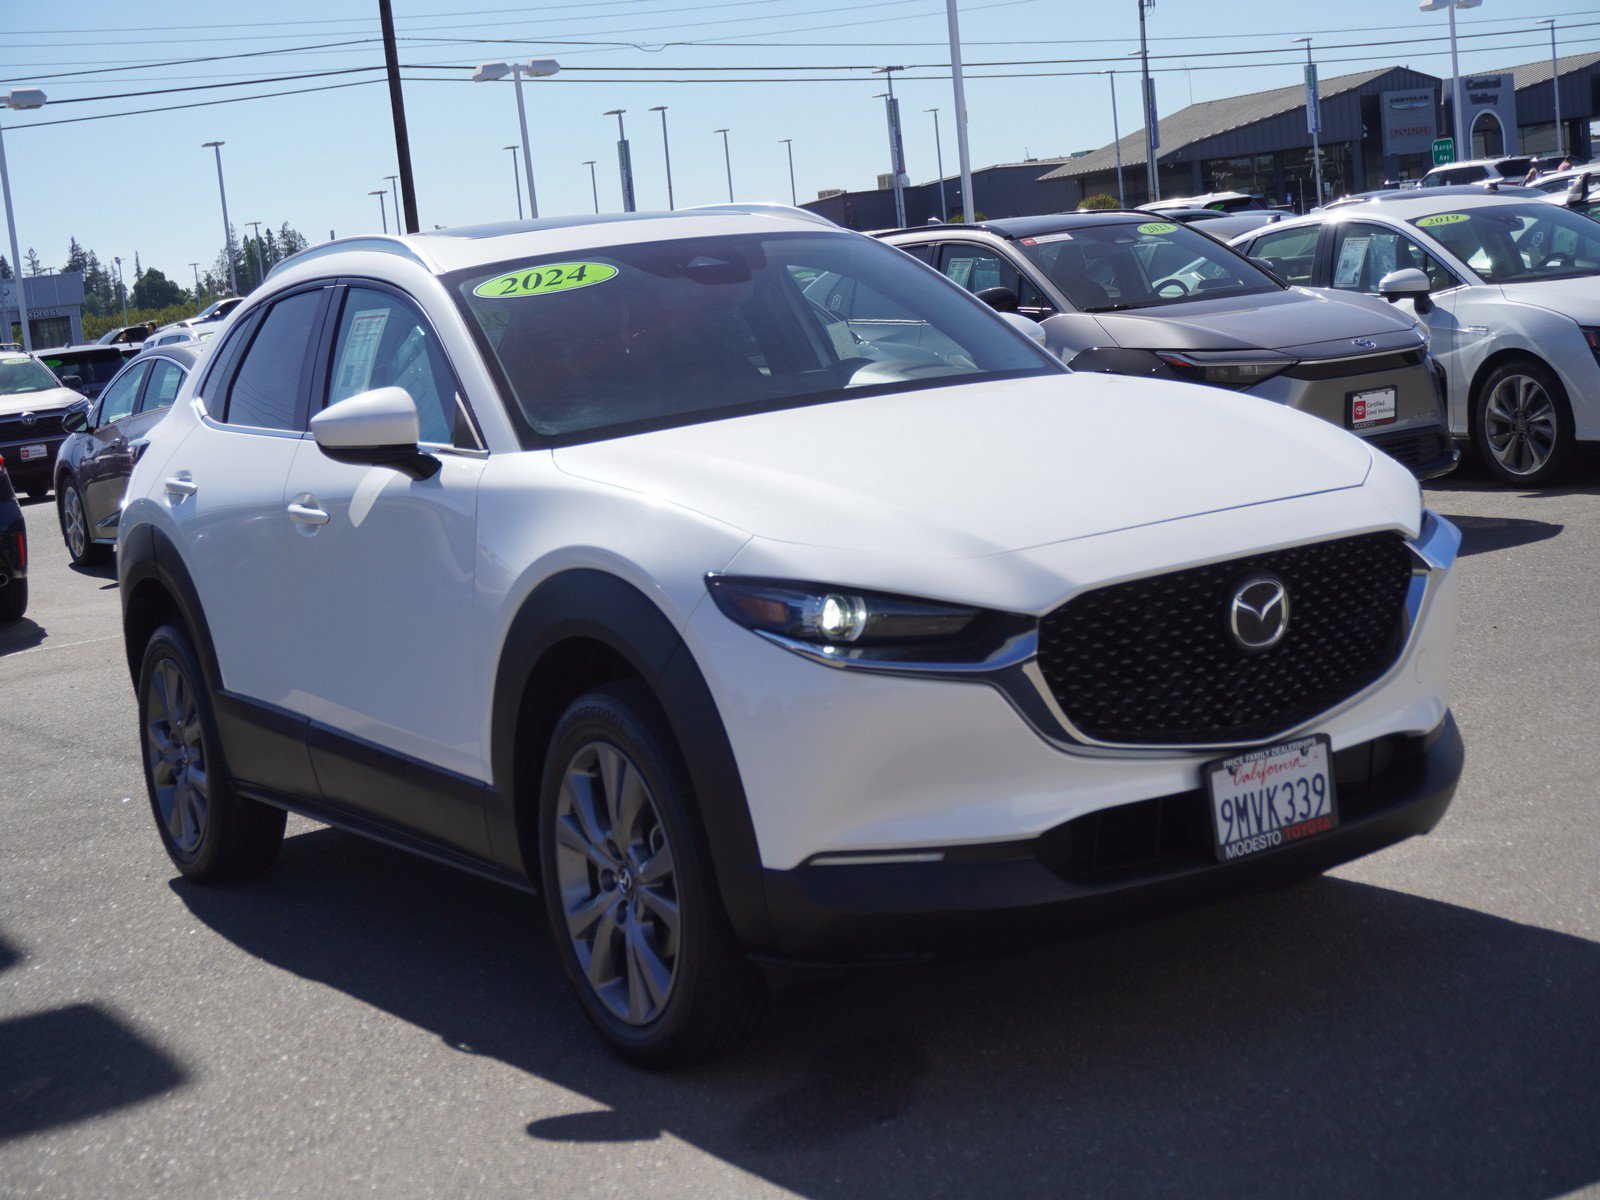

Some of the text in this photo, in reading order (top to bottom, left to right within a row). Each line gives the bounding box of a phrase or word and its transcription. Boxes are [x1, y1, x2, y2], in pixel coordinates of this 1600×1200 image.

[1389, 95, 1429, 103] CHRYSLER
[1427, 214, 1460, 226] 2019
[499, 265, 588, 295] 2024
[26, 307, 62, 319] xpress
[1223, 737, 1317, 769] PRICE FAMILY DEALERSHIPS
[1233, 756, 1309, 788] California
[1220, 773, 1326, 844] 9MVK339
[1225, 817, 1332, 860] MODESTO TOYOTA
